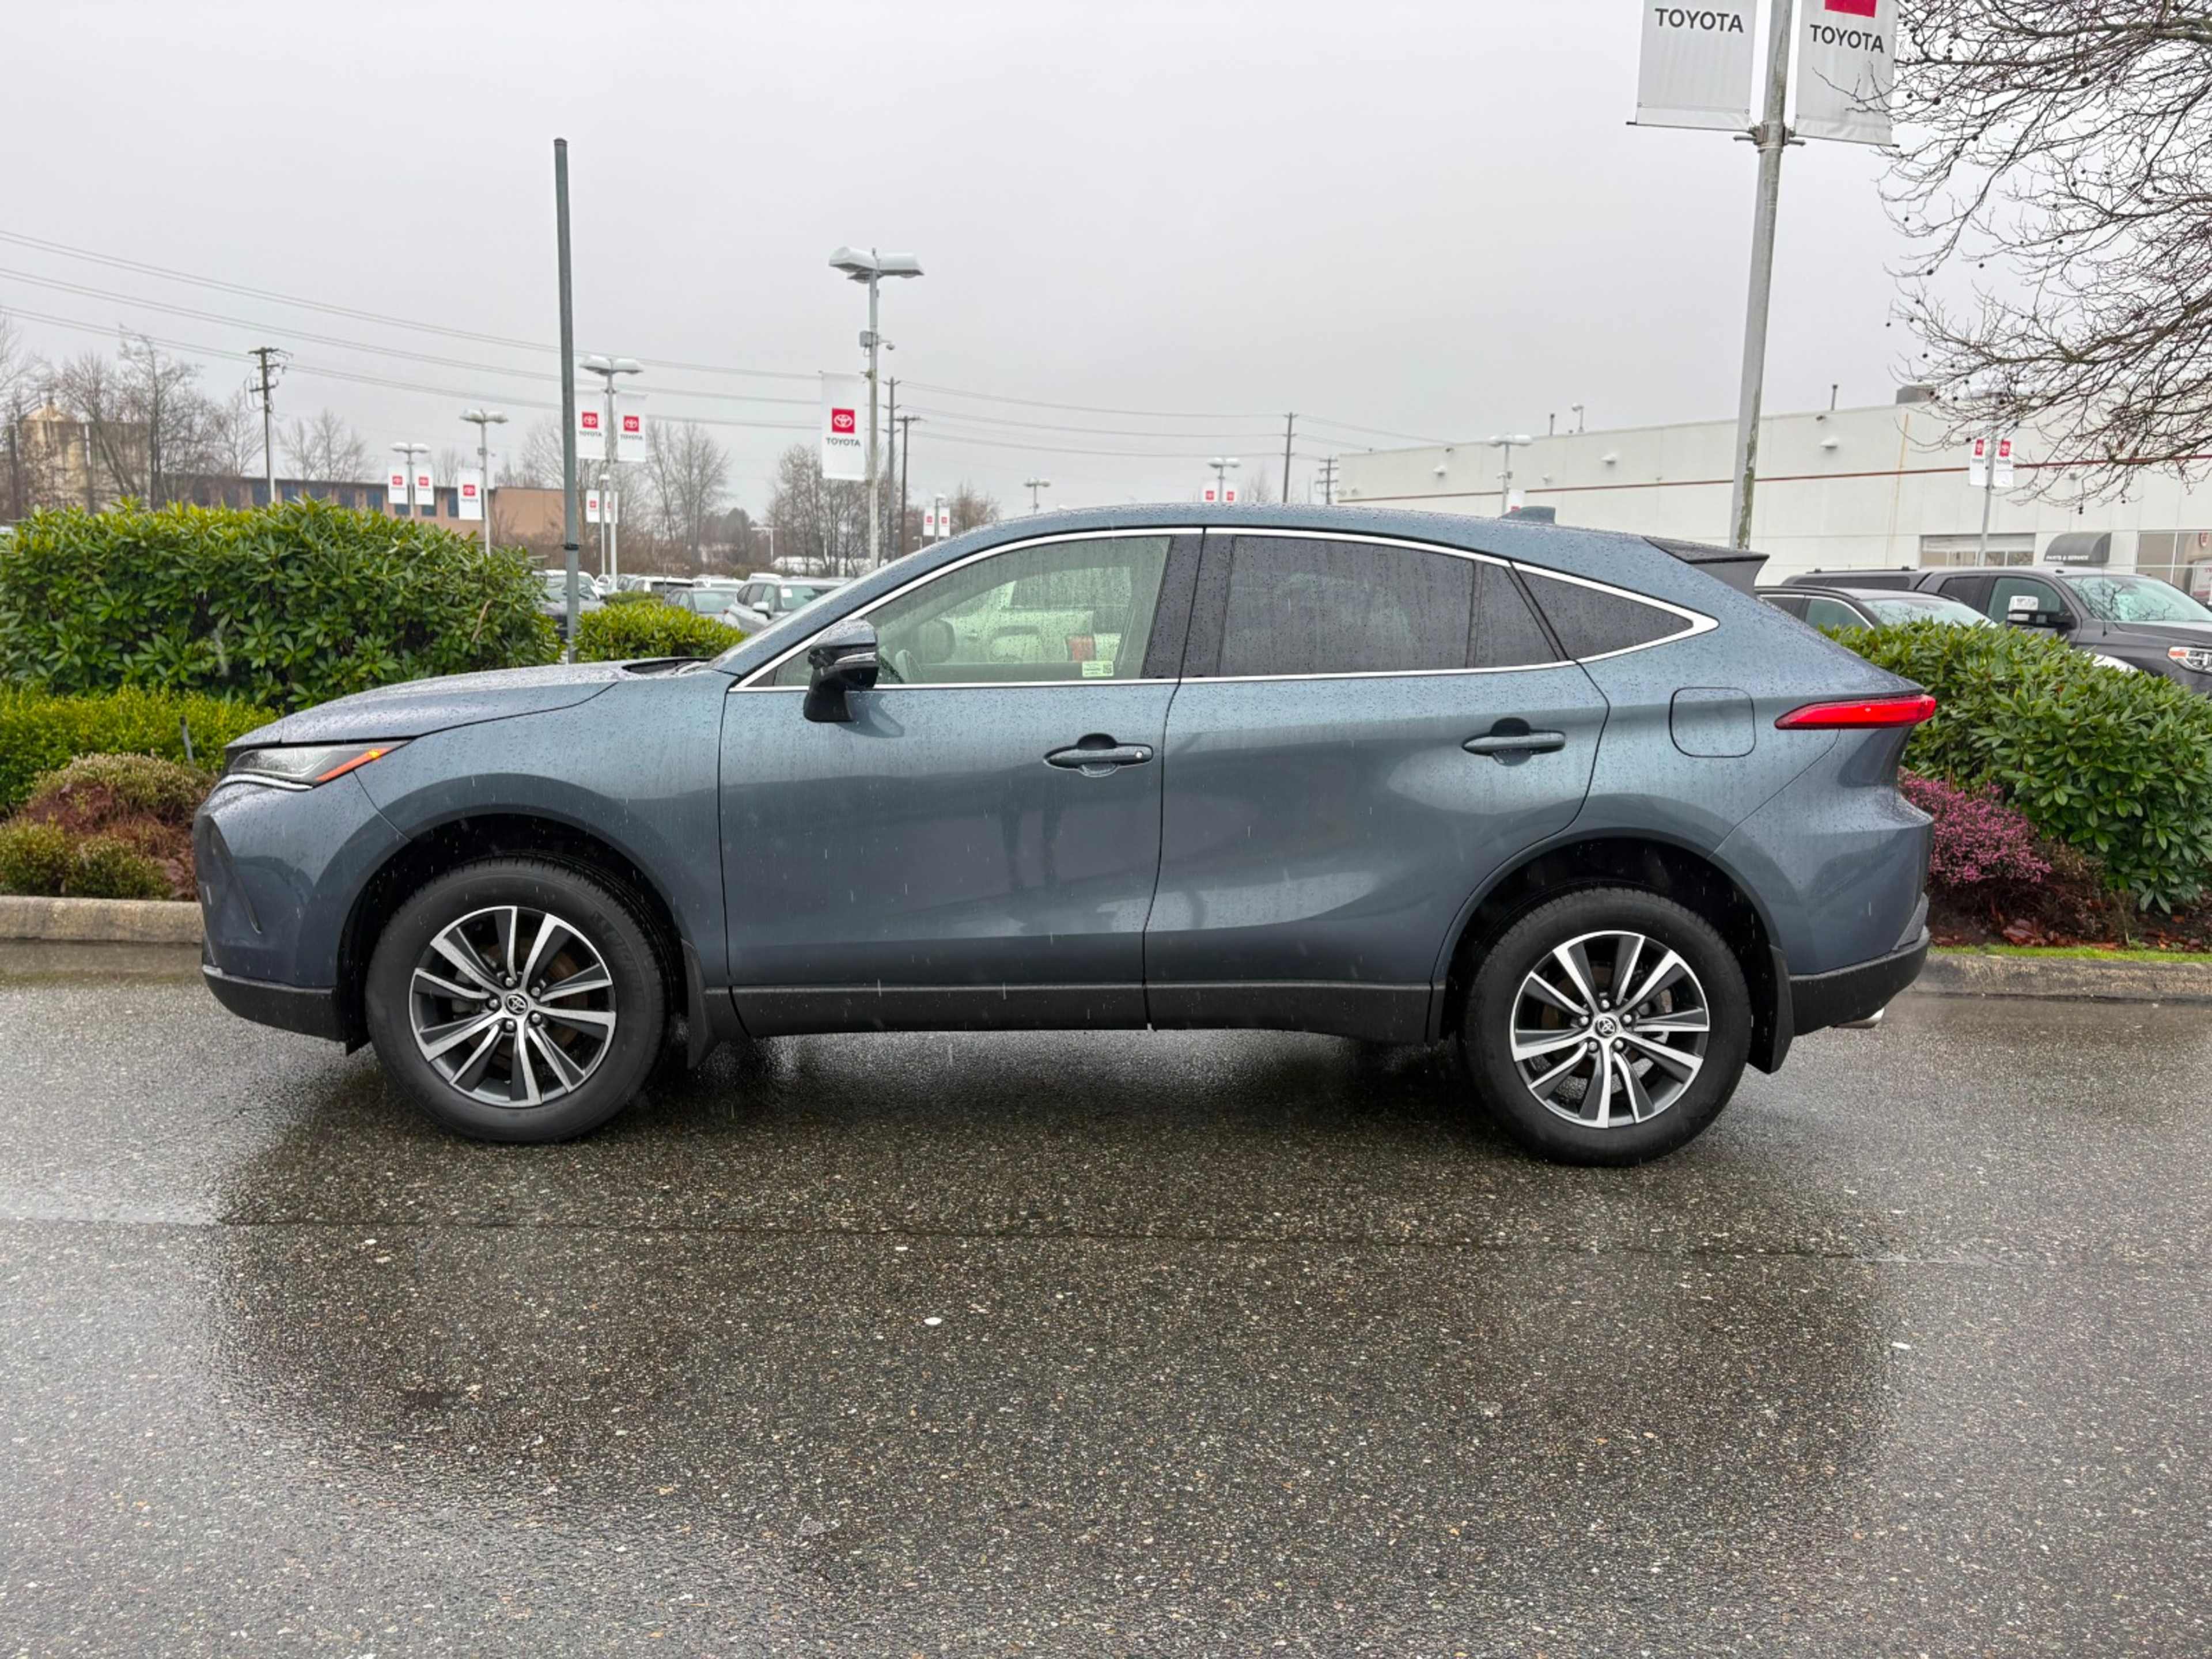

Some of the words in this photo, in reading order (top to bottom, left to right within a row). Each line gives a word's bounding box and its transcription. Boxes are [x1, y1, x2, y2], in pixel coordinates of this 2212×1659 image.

[1655, 8, 1744, 33] TOYOTA
[1809, 24, 1884, 54] TOYOTA
[825, 437, 861, 447] TOYOTA
